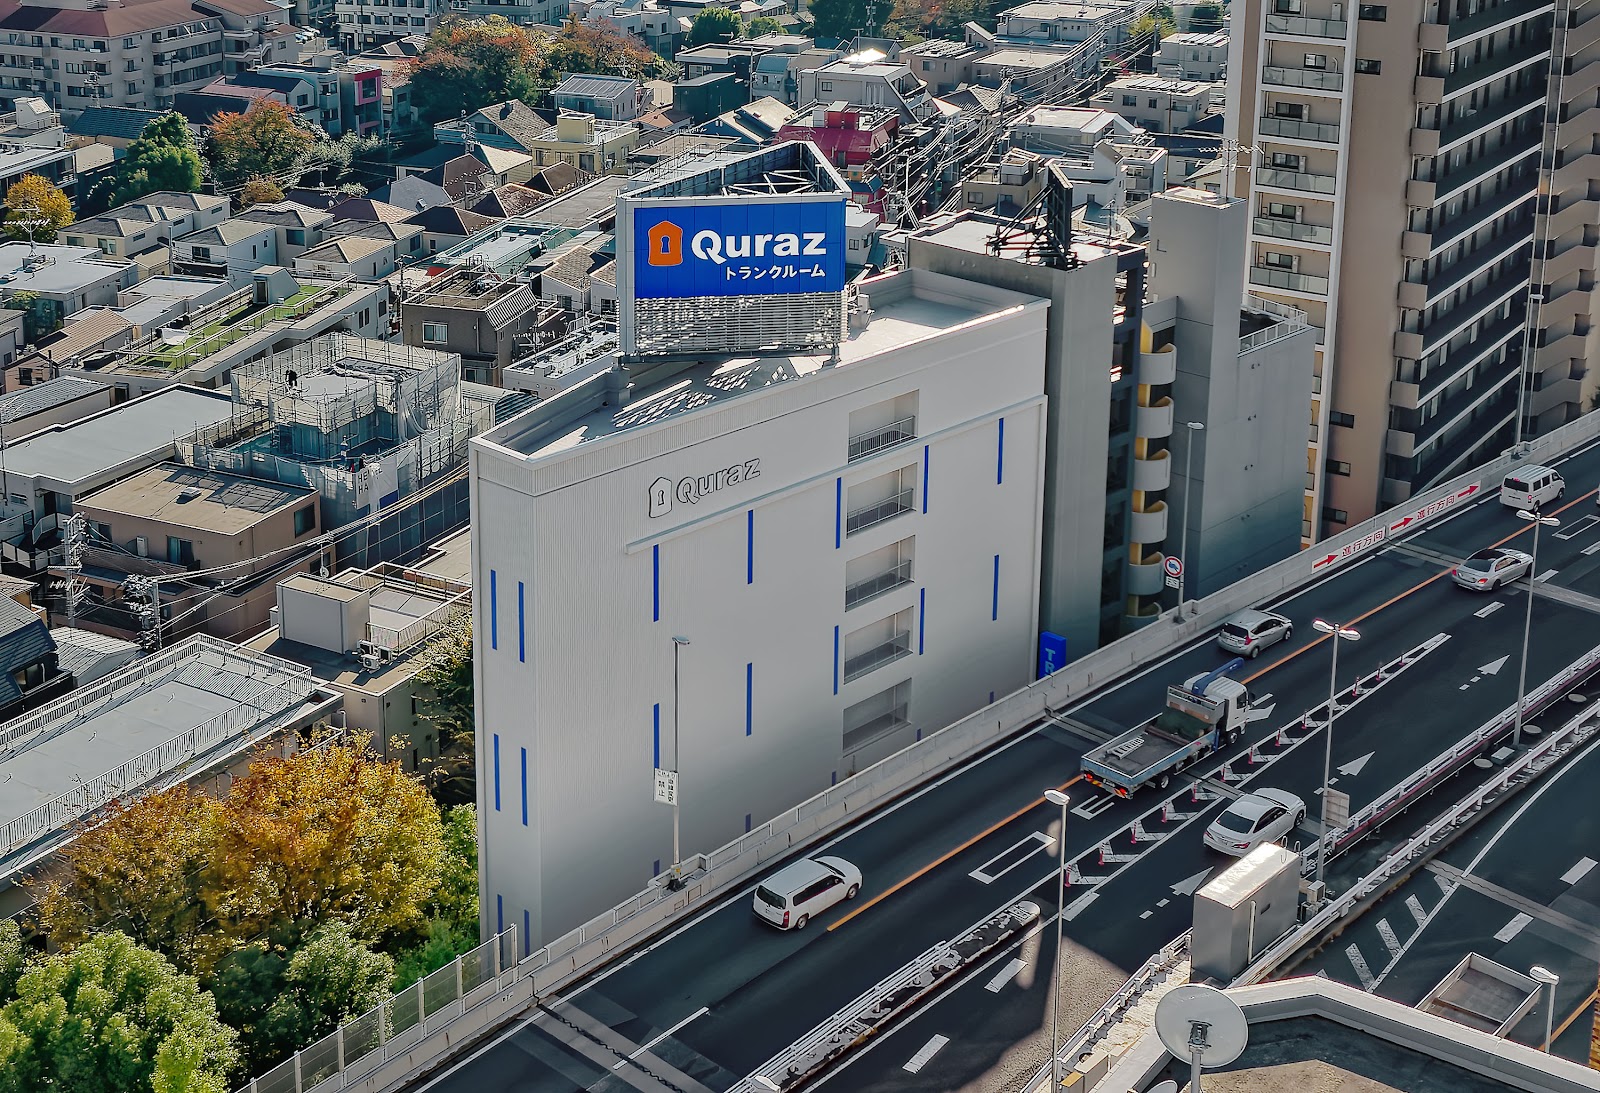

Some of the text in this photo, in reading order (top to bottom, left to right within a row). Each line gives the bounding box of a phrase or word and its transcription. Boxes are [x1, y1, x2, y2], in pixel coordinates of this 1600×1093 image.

[691, 229, 827, 265] Quraz
[726, 263, 826, 281] トランクルーム
[676, 458, 761, 505] Quraz
[1416, 495, 1455, 521] 進行方向
[1342, 530, 1383, 557] 進行方向
